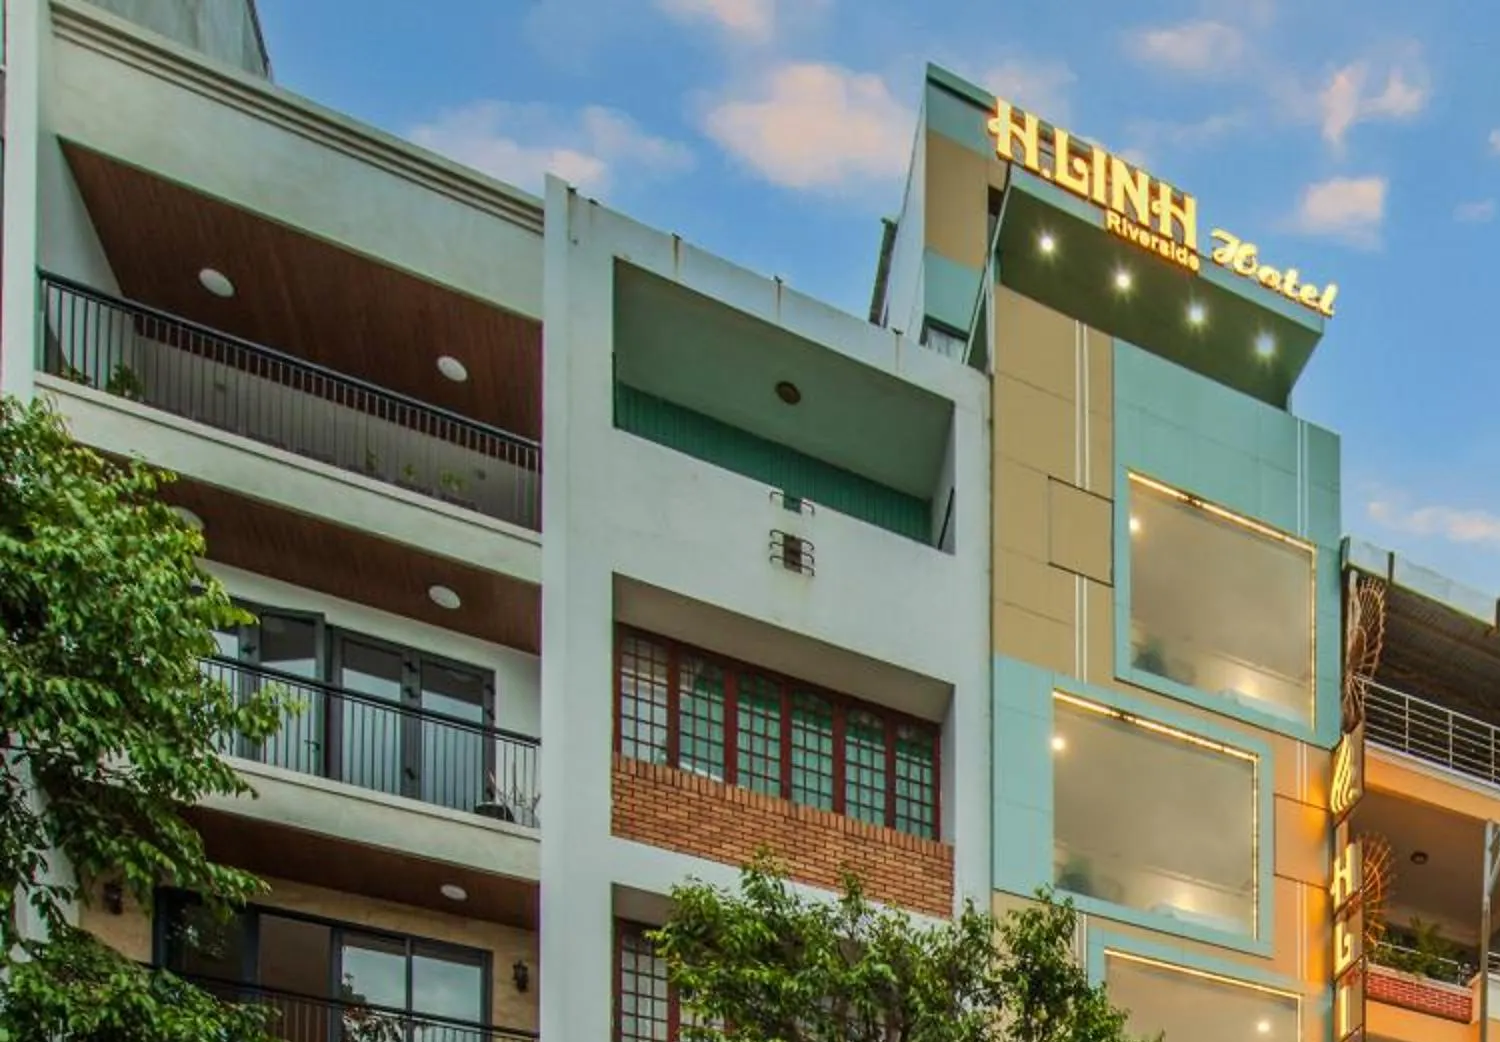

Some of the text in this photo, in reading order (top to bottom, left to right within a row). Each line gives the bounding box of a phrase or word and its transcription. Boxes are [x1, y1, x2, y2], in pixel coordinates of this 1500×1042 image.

[988, 97, 1198, 250] H.LINH
[1105, 208, 1200, 273] Riverside
[1210, 227, 1338, 317] Hotel
